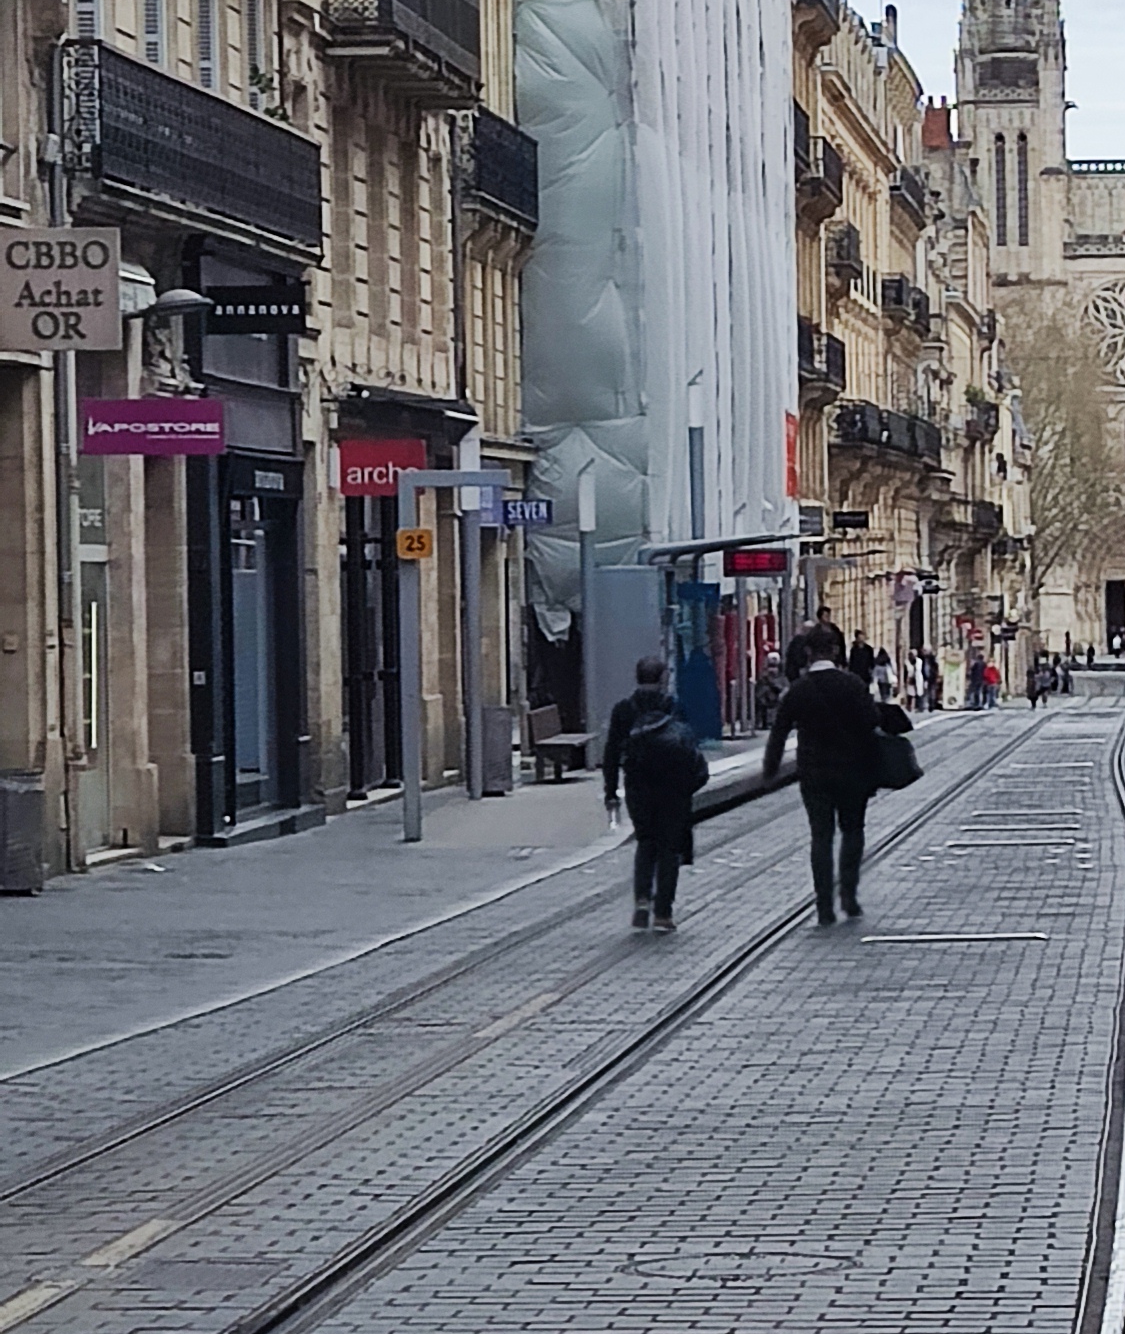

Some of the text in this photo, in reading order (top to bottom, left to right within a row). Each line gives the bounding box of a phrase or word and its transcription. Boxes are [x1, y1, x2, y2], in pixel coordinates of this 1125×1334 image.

[5, 240, 110, 270] CBBO
[14, 280, 104, 308] Achat
[31, 311, 87, 340] OR
[88, 415, 220, 435] VAPOSTORE
[346, 461, 420, 485] arch
[507, 501, 547, 520] SEVEN
[405, 534, 426, 552] 25
